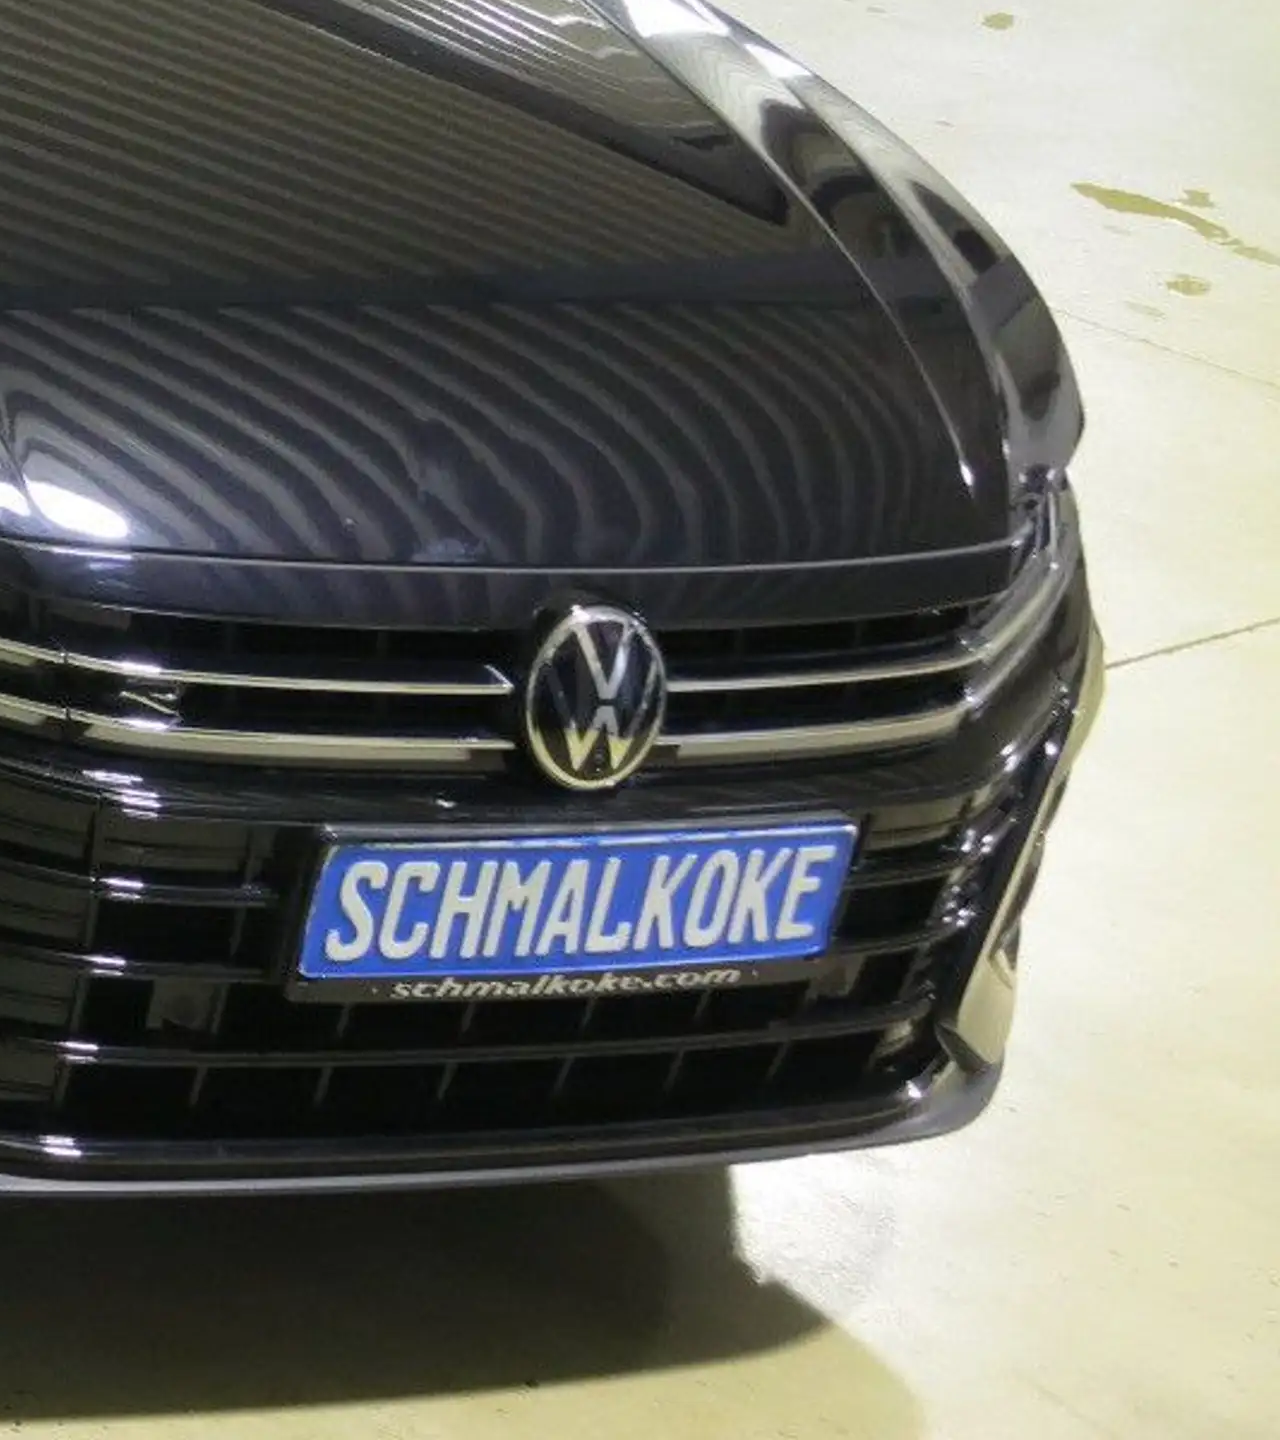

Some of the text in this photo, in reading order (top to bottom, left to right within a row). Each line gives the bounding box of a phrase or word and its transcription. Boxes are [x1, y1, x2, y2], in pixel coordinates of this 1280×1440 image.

[527, 605, 666, 790] VW
[325, 844, 837, 961] SCHMALKOKE
[391, 968, 740, 1000] schmalkoke.com
